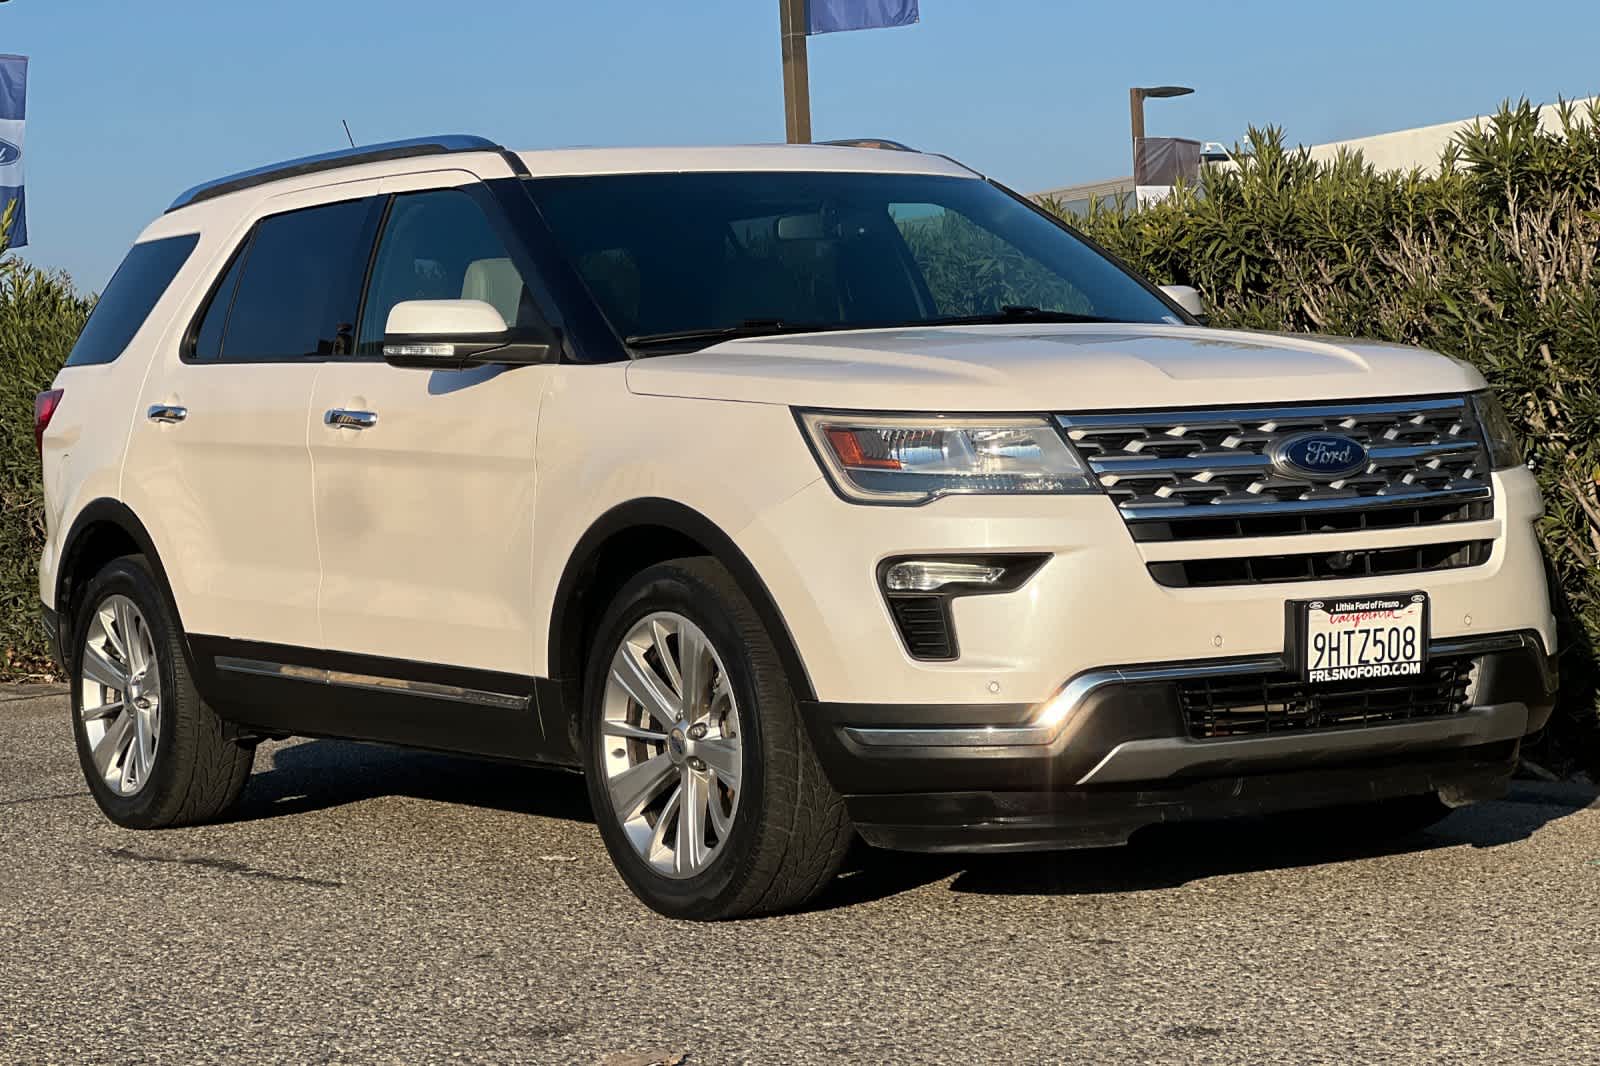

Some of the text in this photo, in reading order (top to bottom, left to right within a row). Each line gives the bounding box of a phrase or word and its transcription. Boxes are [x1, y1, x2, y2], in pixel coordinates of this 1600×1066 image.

[1305, 440, 1353, 465] Ford
[1335, 600, 1400, 612] Lithia Ford of Fresno
[1313, 625, 1416, 669] 9HTZ508
